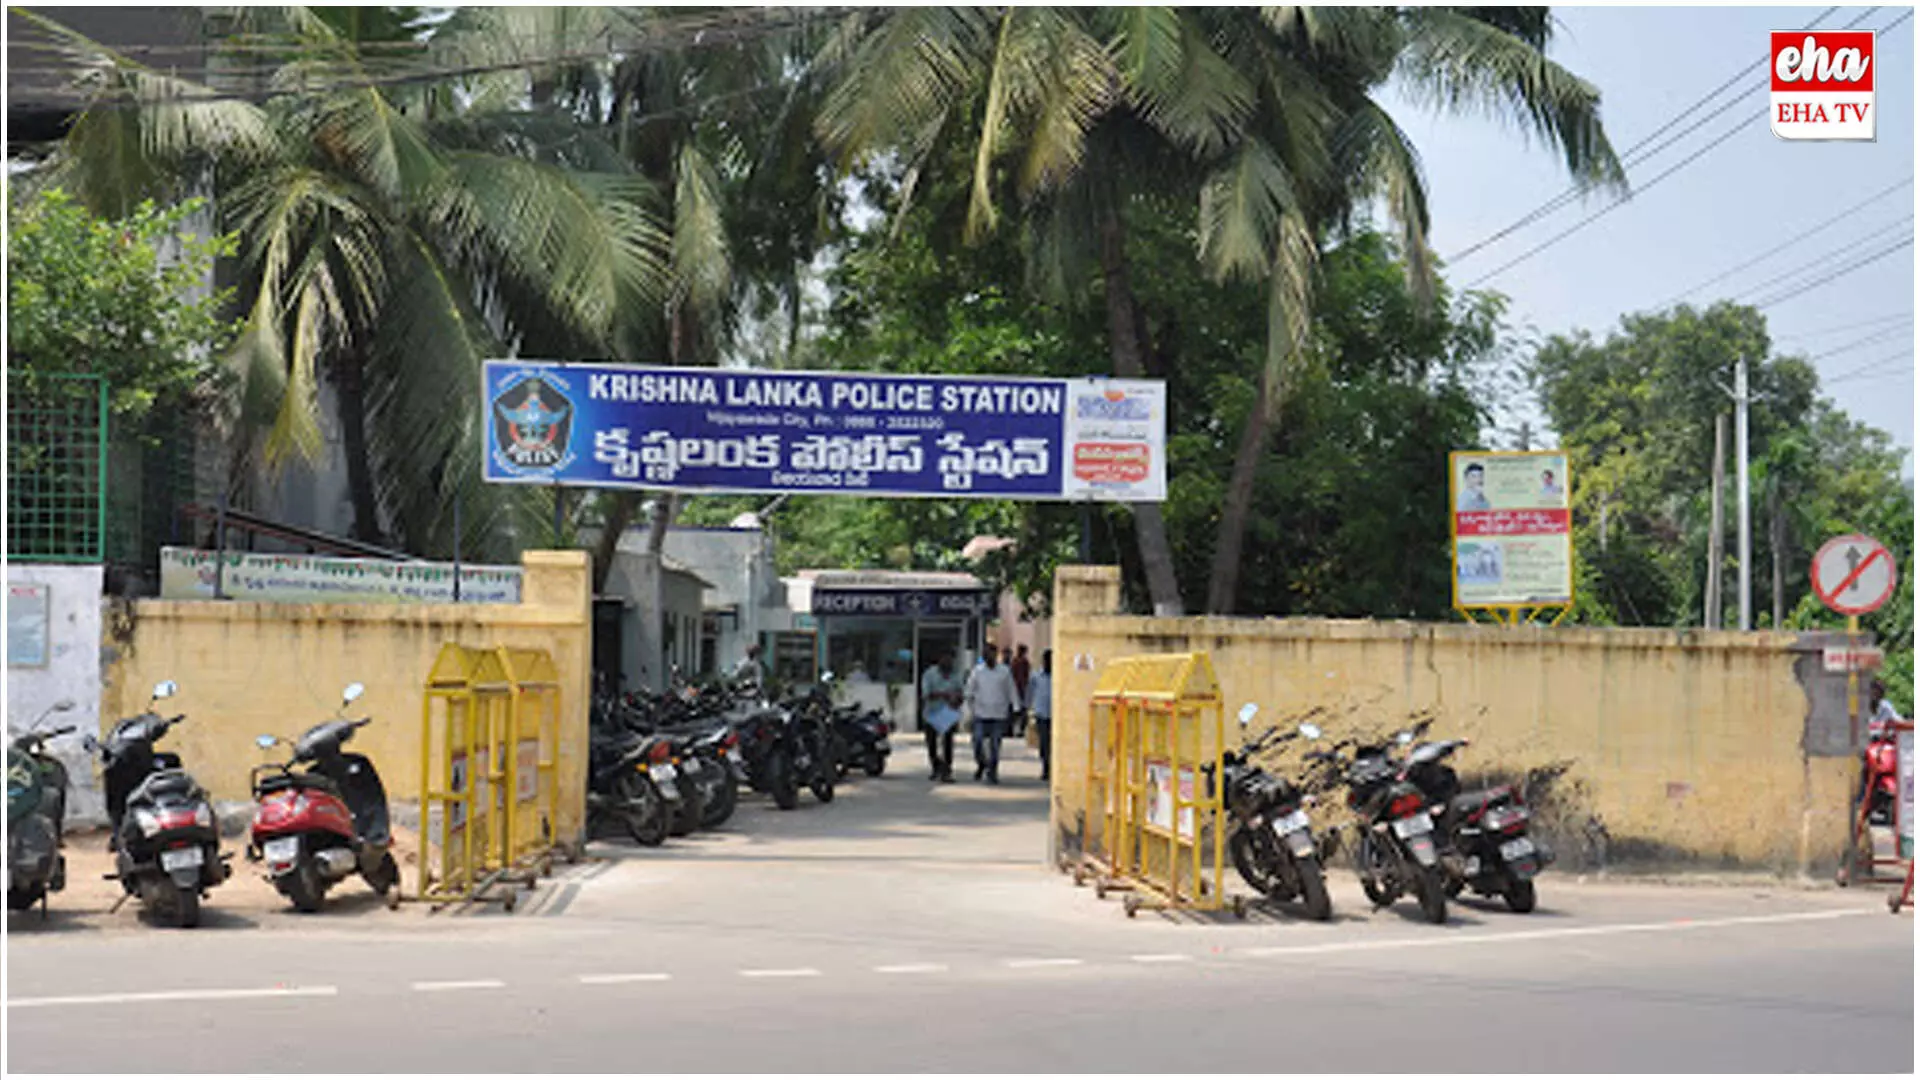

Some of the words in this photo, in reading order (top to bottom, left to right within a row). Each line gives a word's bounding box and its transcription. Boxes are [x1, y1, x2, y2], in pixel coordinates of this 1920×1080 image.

[589, 373, 718, 404] KRISHNA
[726, 379, 822, 408] LANKA
[831, 382, 933, 411] POLICE
[941, 384, 1061, 415] STATION
